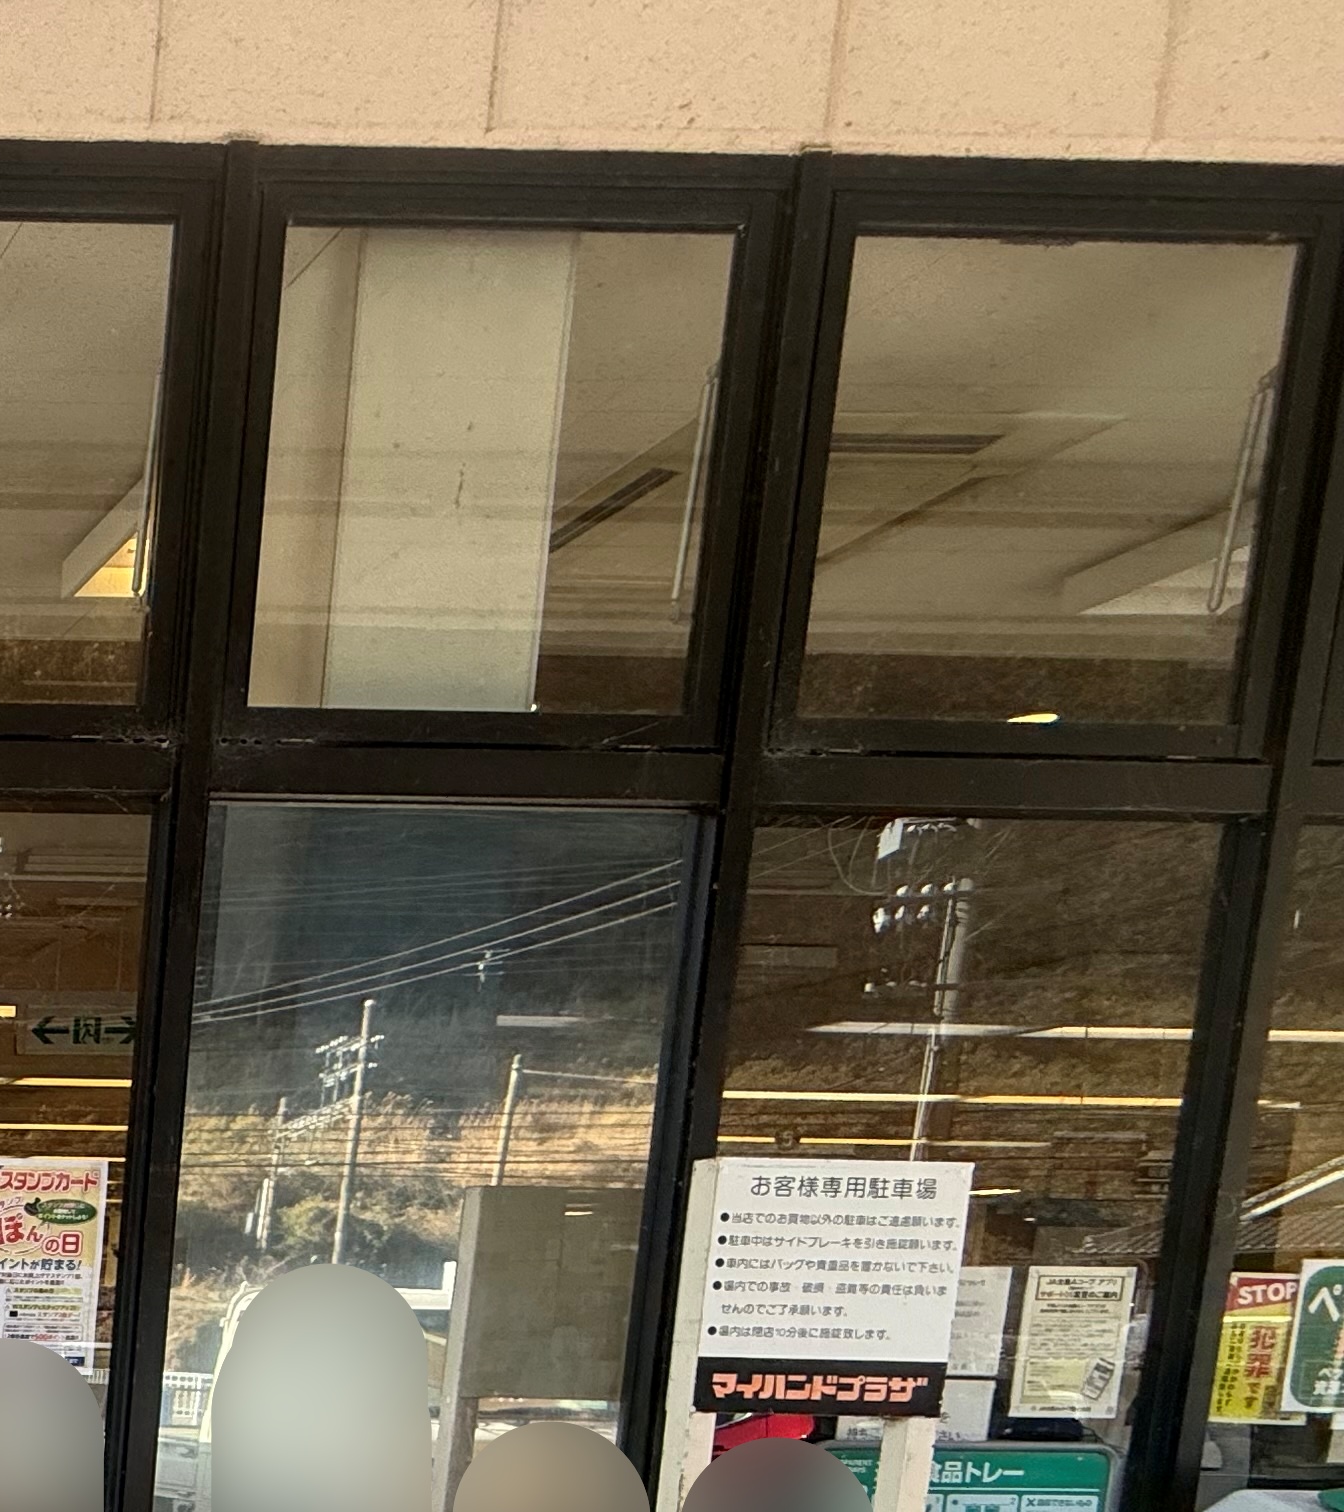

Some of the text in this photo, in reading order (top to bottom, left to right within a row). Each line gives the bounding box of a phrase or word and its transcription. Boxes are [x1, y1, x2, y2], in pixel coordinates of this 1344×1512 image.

[0, 1170, 99, 1192] スタンプカード
[750, 1175, 938, 1200] お客様専用駐車場
[1237, 1281, 1298, 1305] STOP
[712, 1373, 929, 1404] マイハンドプラザ
